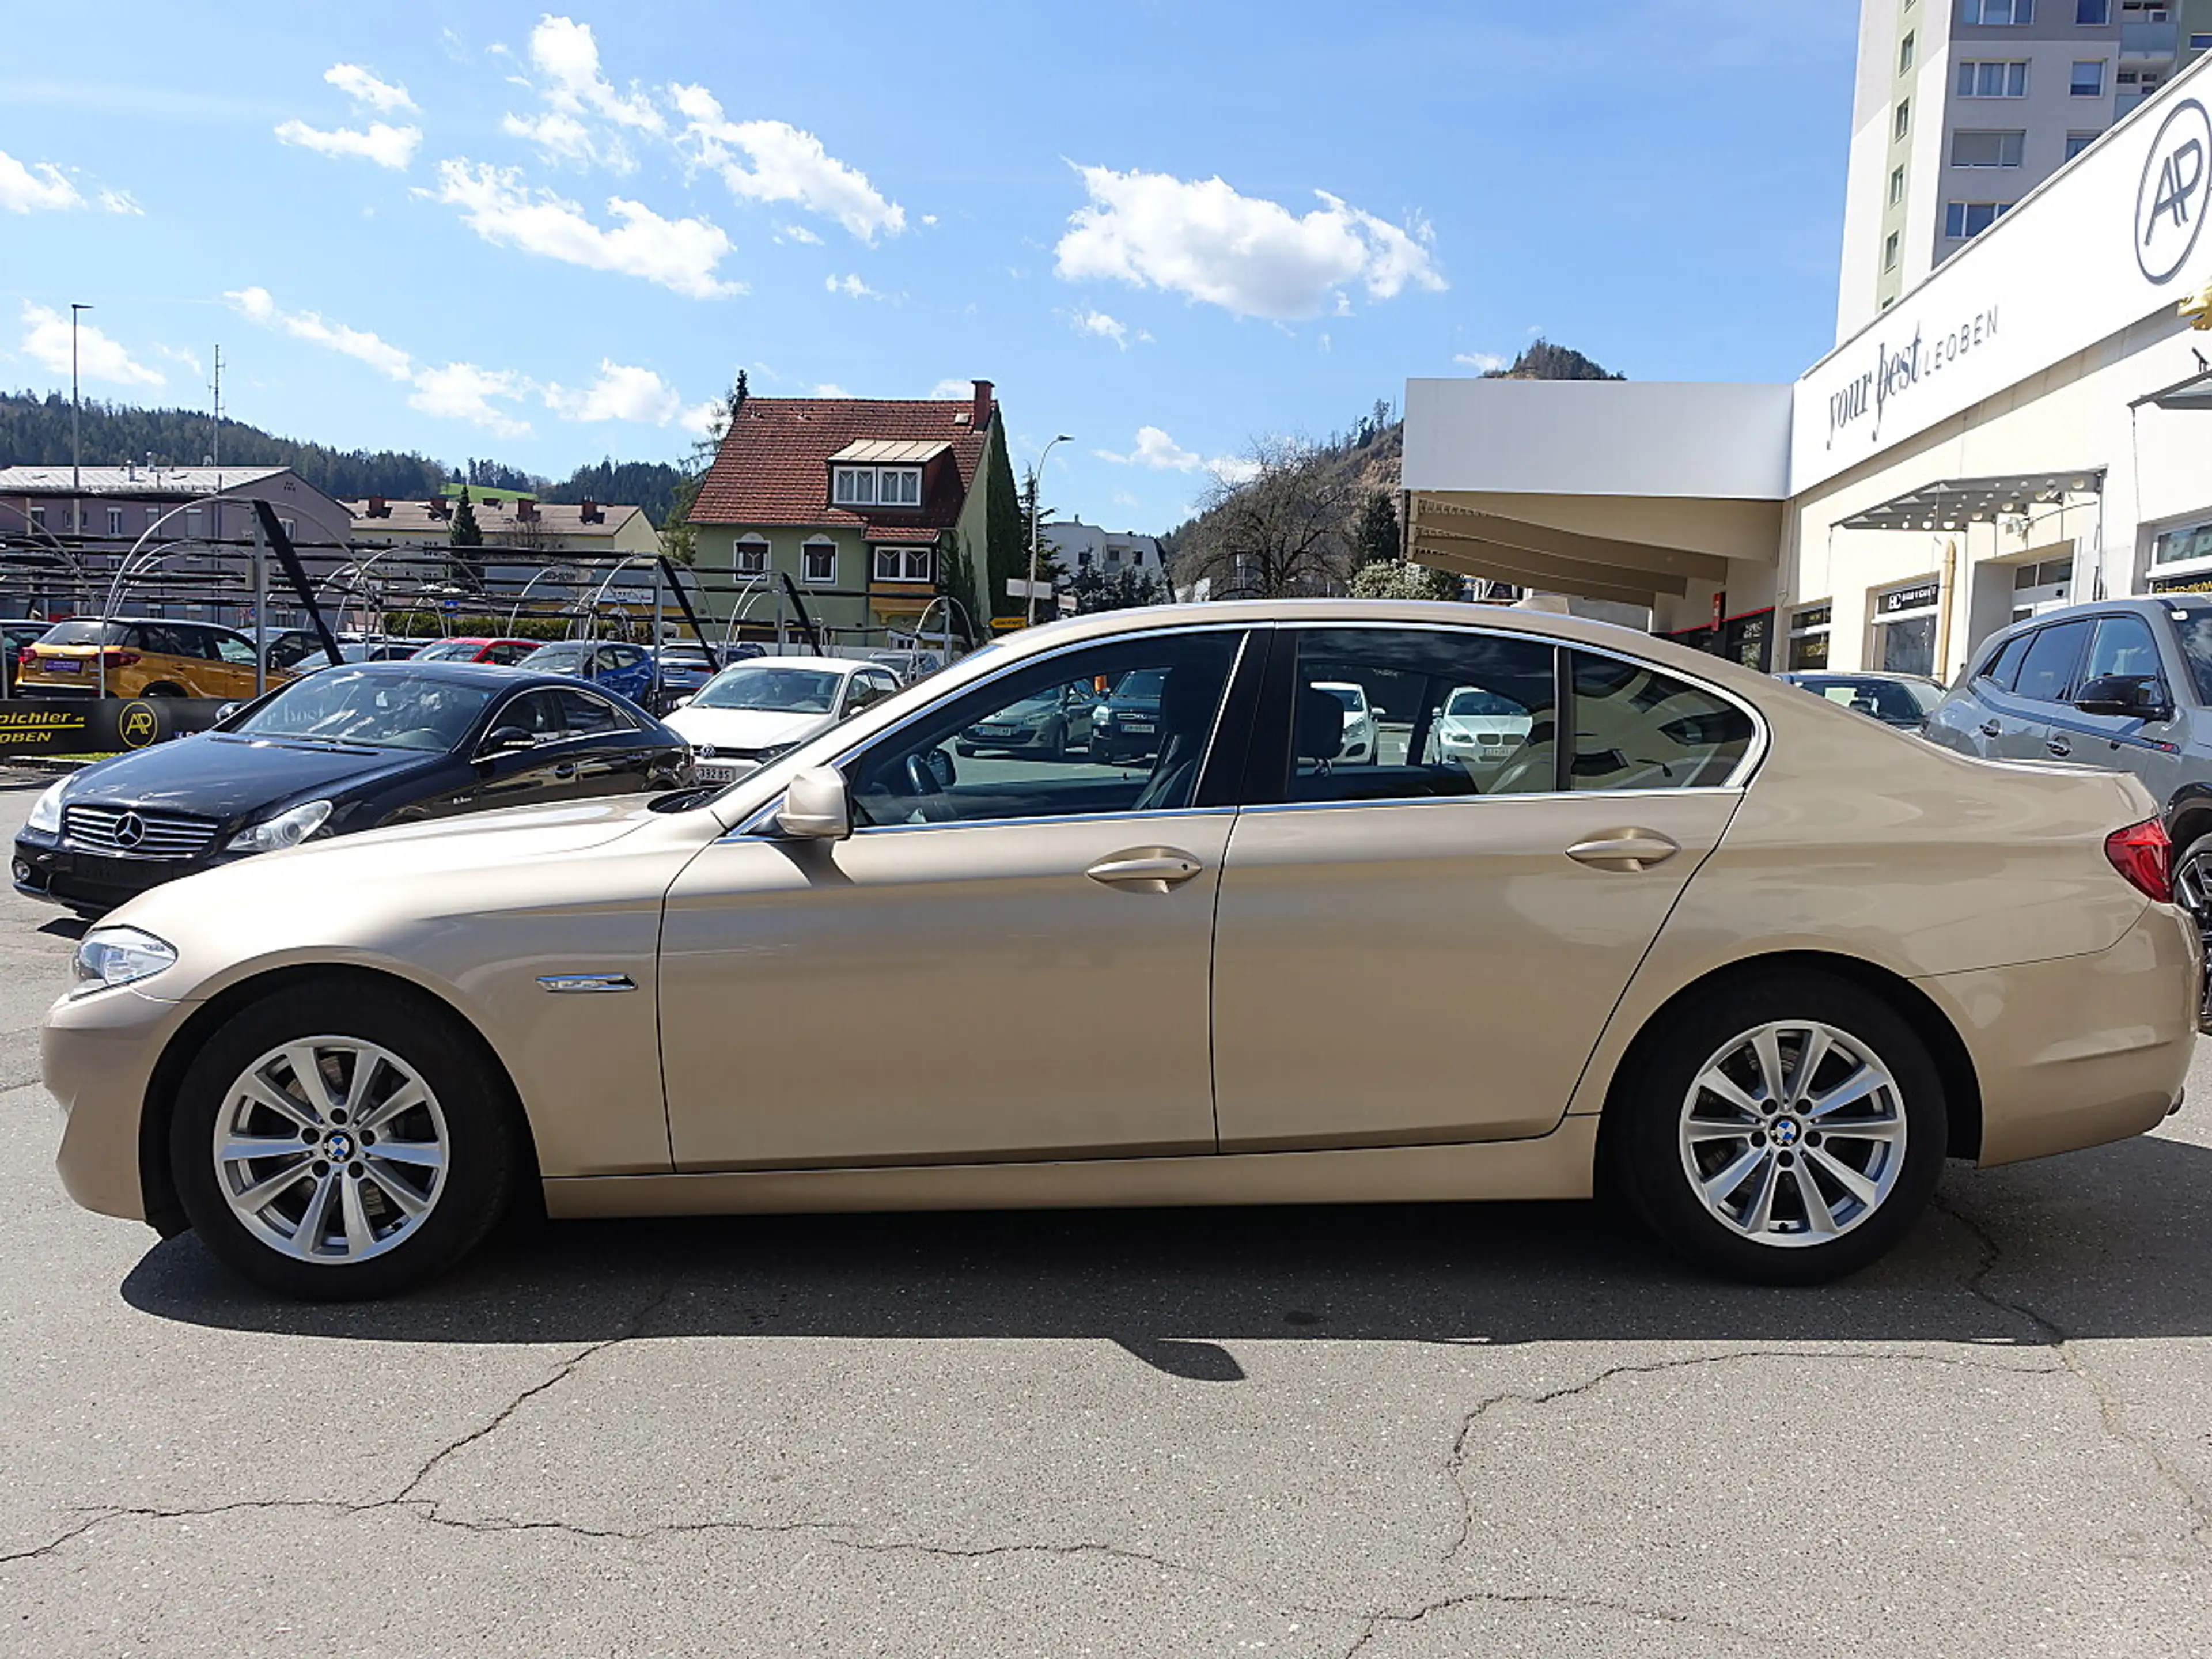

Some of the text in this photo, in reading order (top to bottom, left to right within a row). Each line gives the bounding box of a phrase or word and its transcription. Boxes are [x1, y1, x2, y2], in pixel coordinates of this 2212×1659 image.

[1826, 304, 1998, 450] your best LEOBEN
